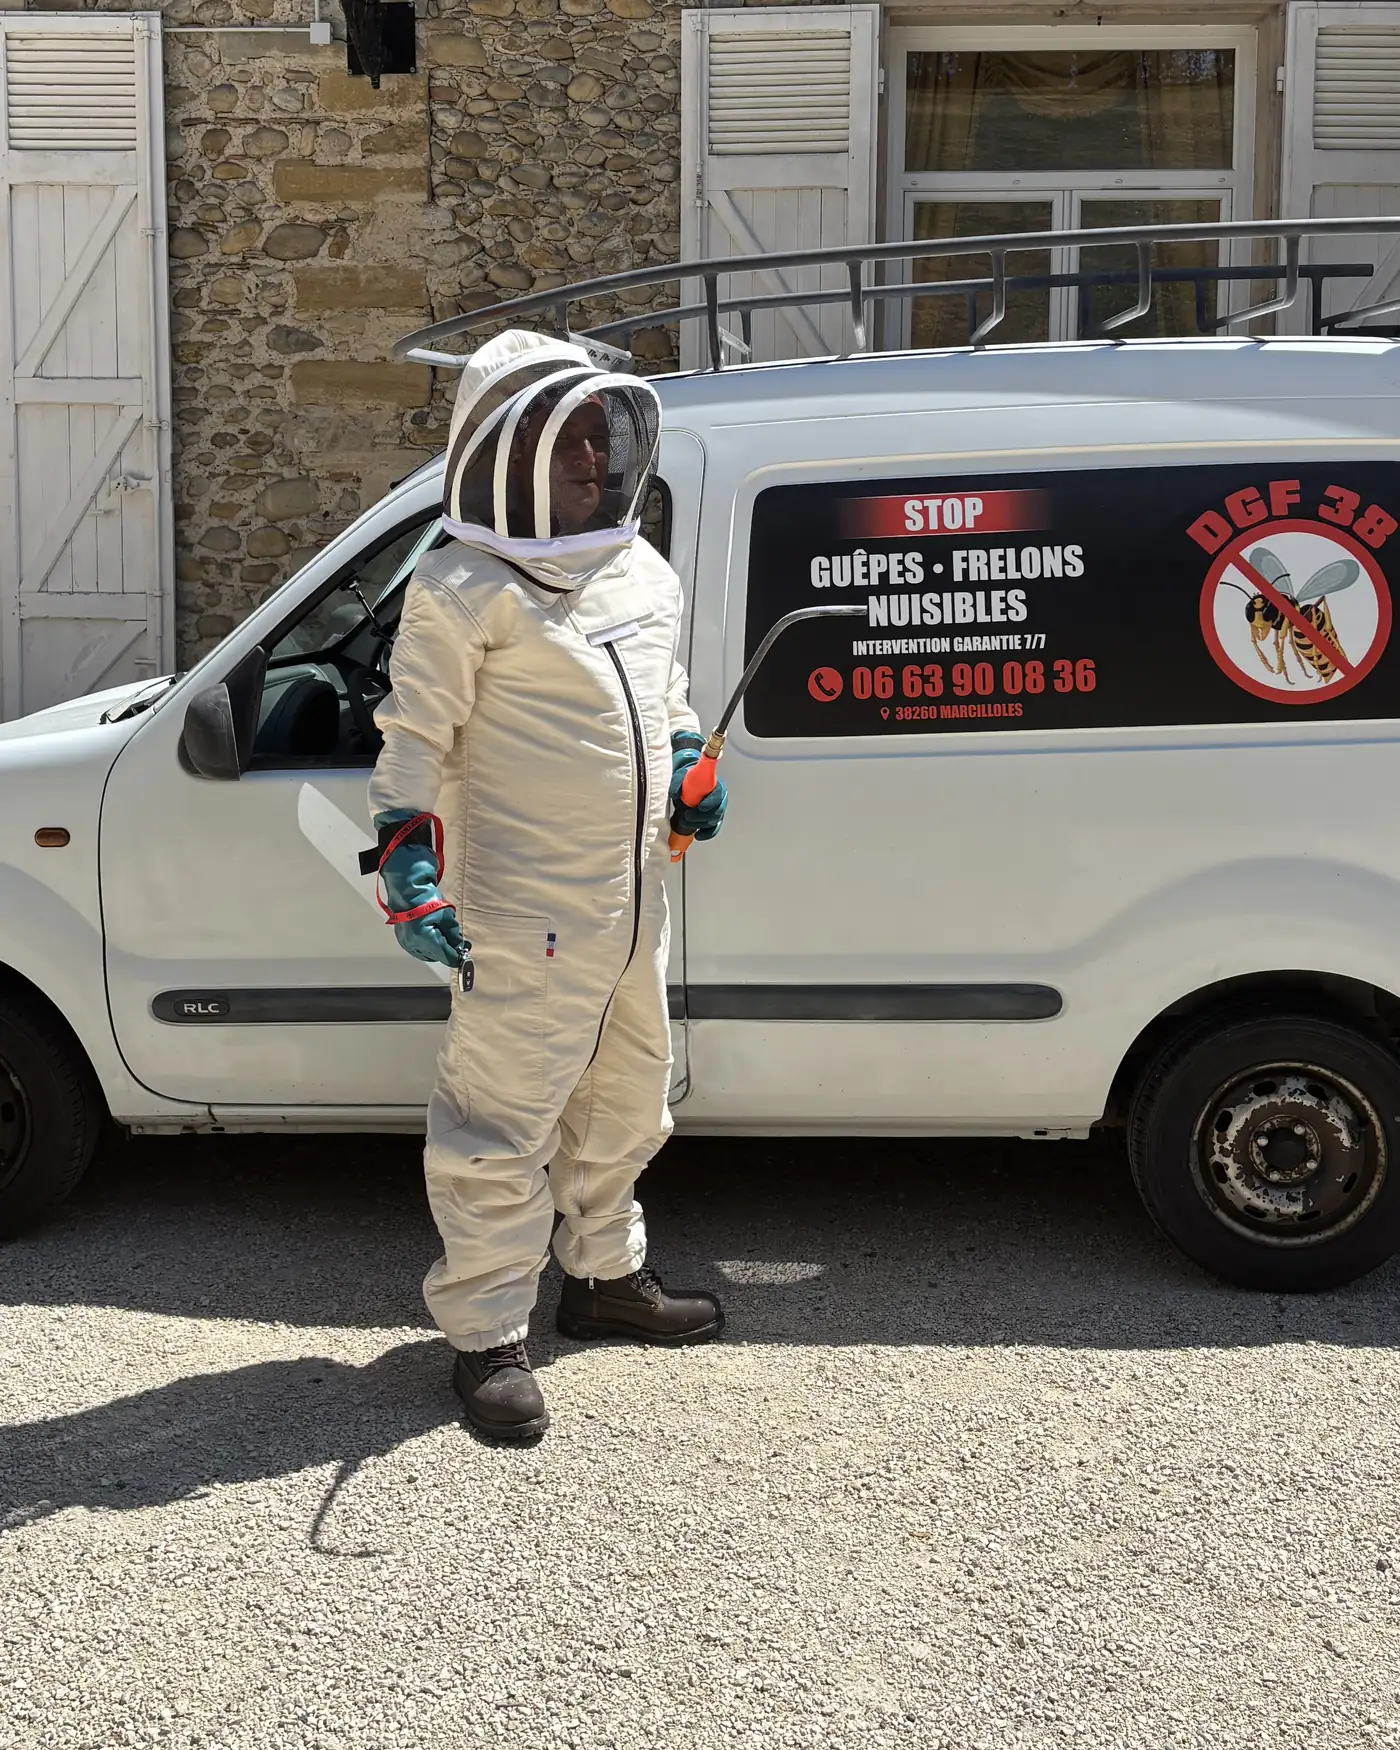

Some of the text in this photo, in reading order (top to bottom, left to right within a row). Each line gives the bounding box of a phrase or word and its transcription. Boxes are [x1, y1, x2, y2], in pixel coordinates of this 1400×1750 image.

[904, 497, 983, 531] STOP
[1185, 480, 1398, 555] DGF 38
[811, 545, 1084, 588] GUÊPES FRELONS
[869, 589, 1027, 626] NUISIBLES
[853, 634, 1045, 655] INTERVENTION GARANTIE 7/7
[852, 659, 1095, 699] 06 63 90 08 36
[895, 703, 1023, 720] 38260 MARCILLOLES
[183, 1002, 220, 1013] RLC
